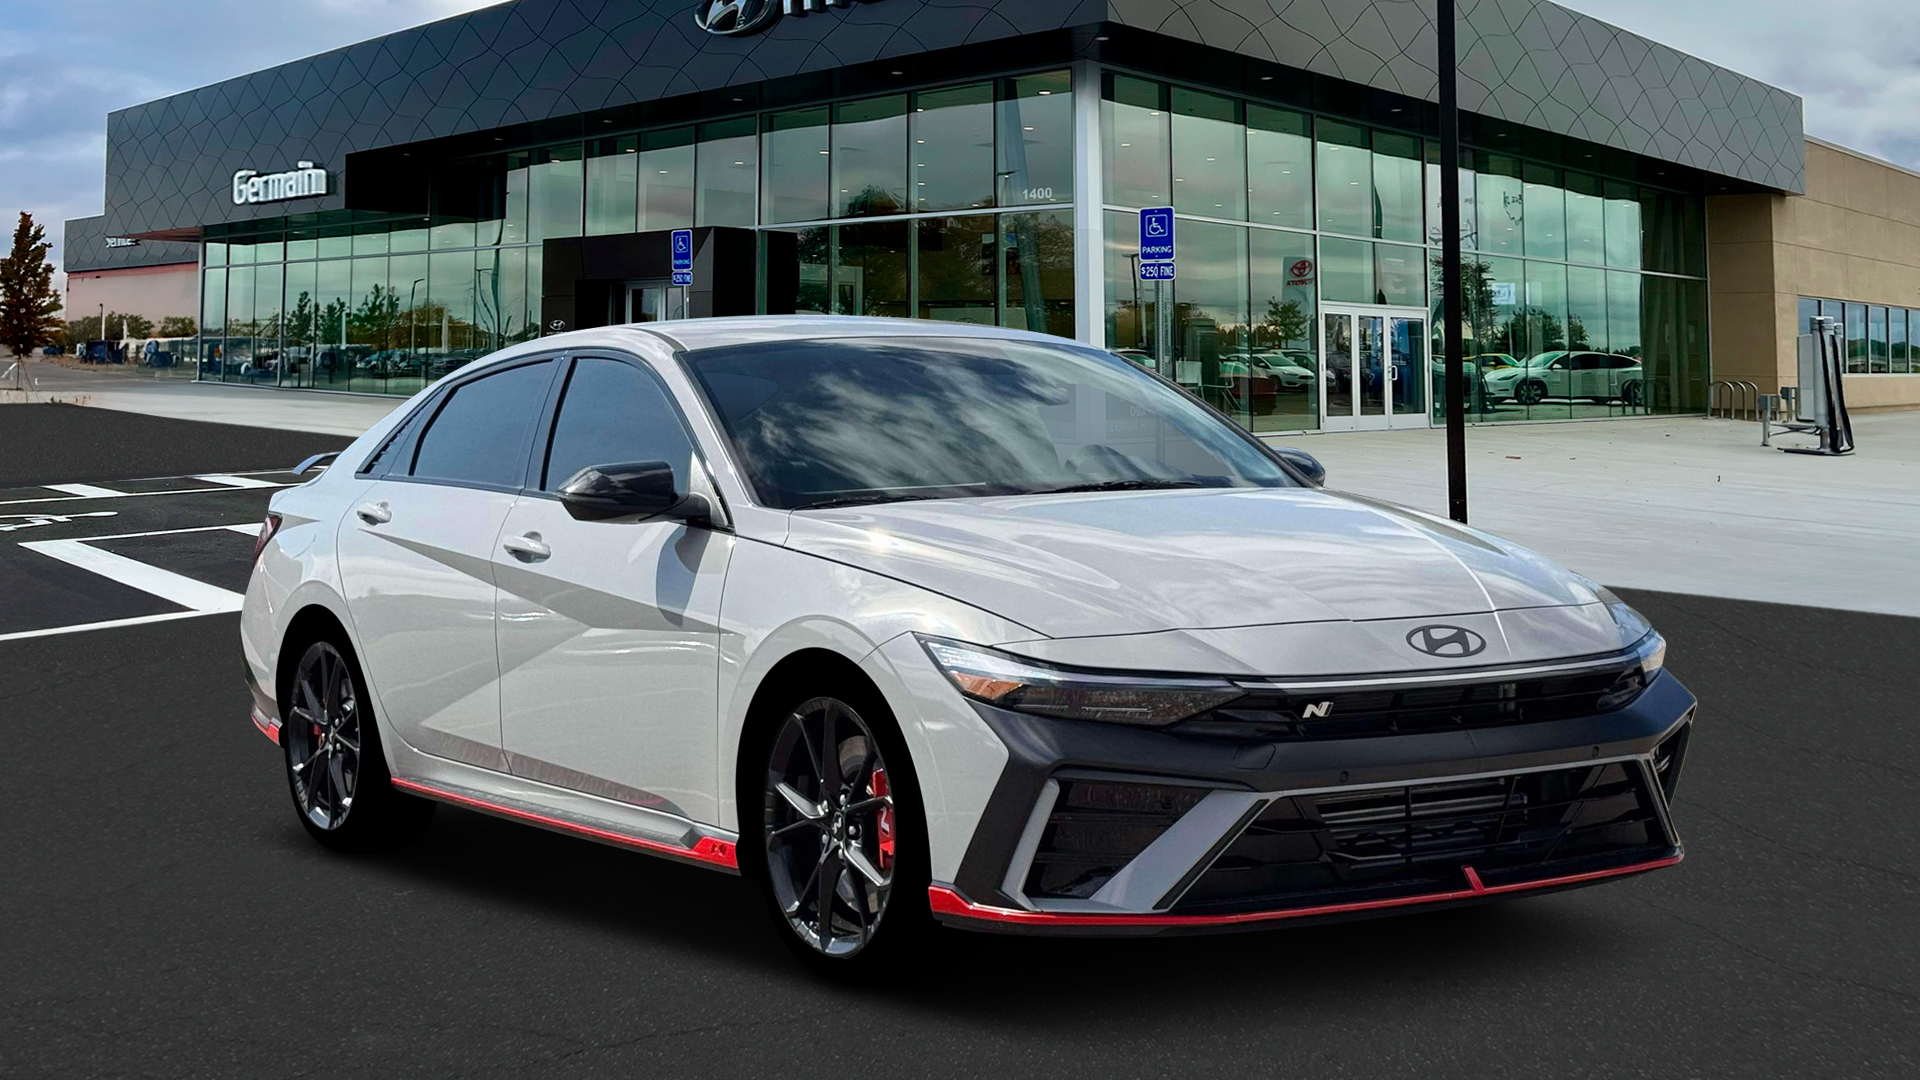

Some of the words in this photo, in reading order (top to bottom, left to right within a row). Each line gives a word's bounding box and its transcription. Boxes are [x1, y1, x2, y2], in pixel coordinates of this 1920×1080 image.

[233, 161, 327, 205] Germain
[1022, 187, 1052, 199] 1400
[1142, 245, 1172, 254] PARKING
[1141, 266, 1159, 277] $250
[1160, 265, 1174, 276] FINE
